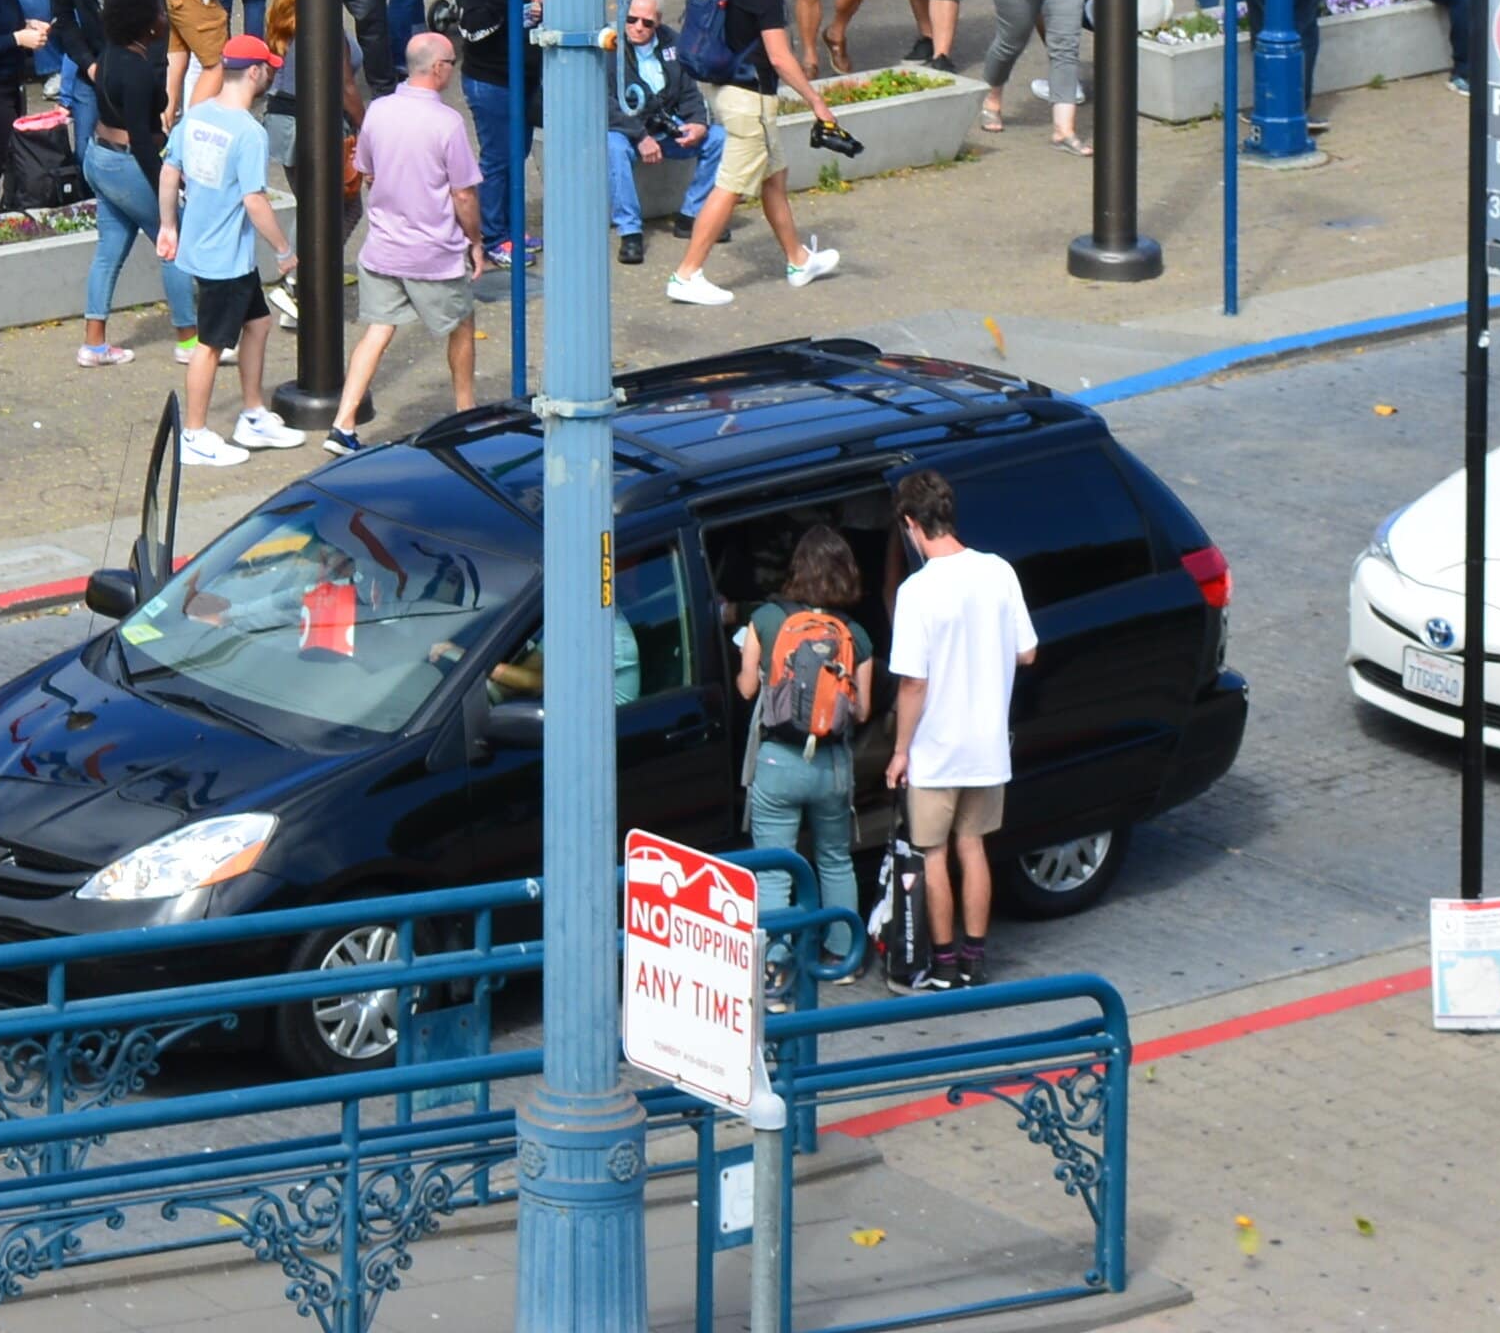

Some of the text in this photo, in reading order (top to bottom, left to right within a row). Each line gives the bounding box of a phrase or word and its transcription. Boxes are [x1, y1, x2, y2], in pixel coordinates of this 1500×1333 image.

[601, 531, 612, 608] 168
[631, 896, 749, 971] NO STOPPING
[635, 960, 744, 1035] ANY TIME
